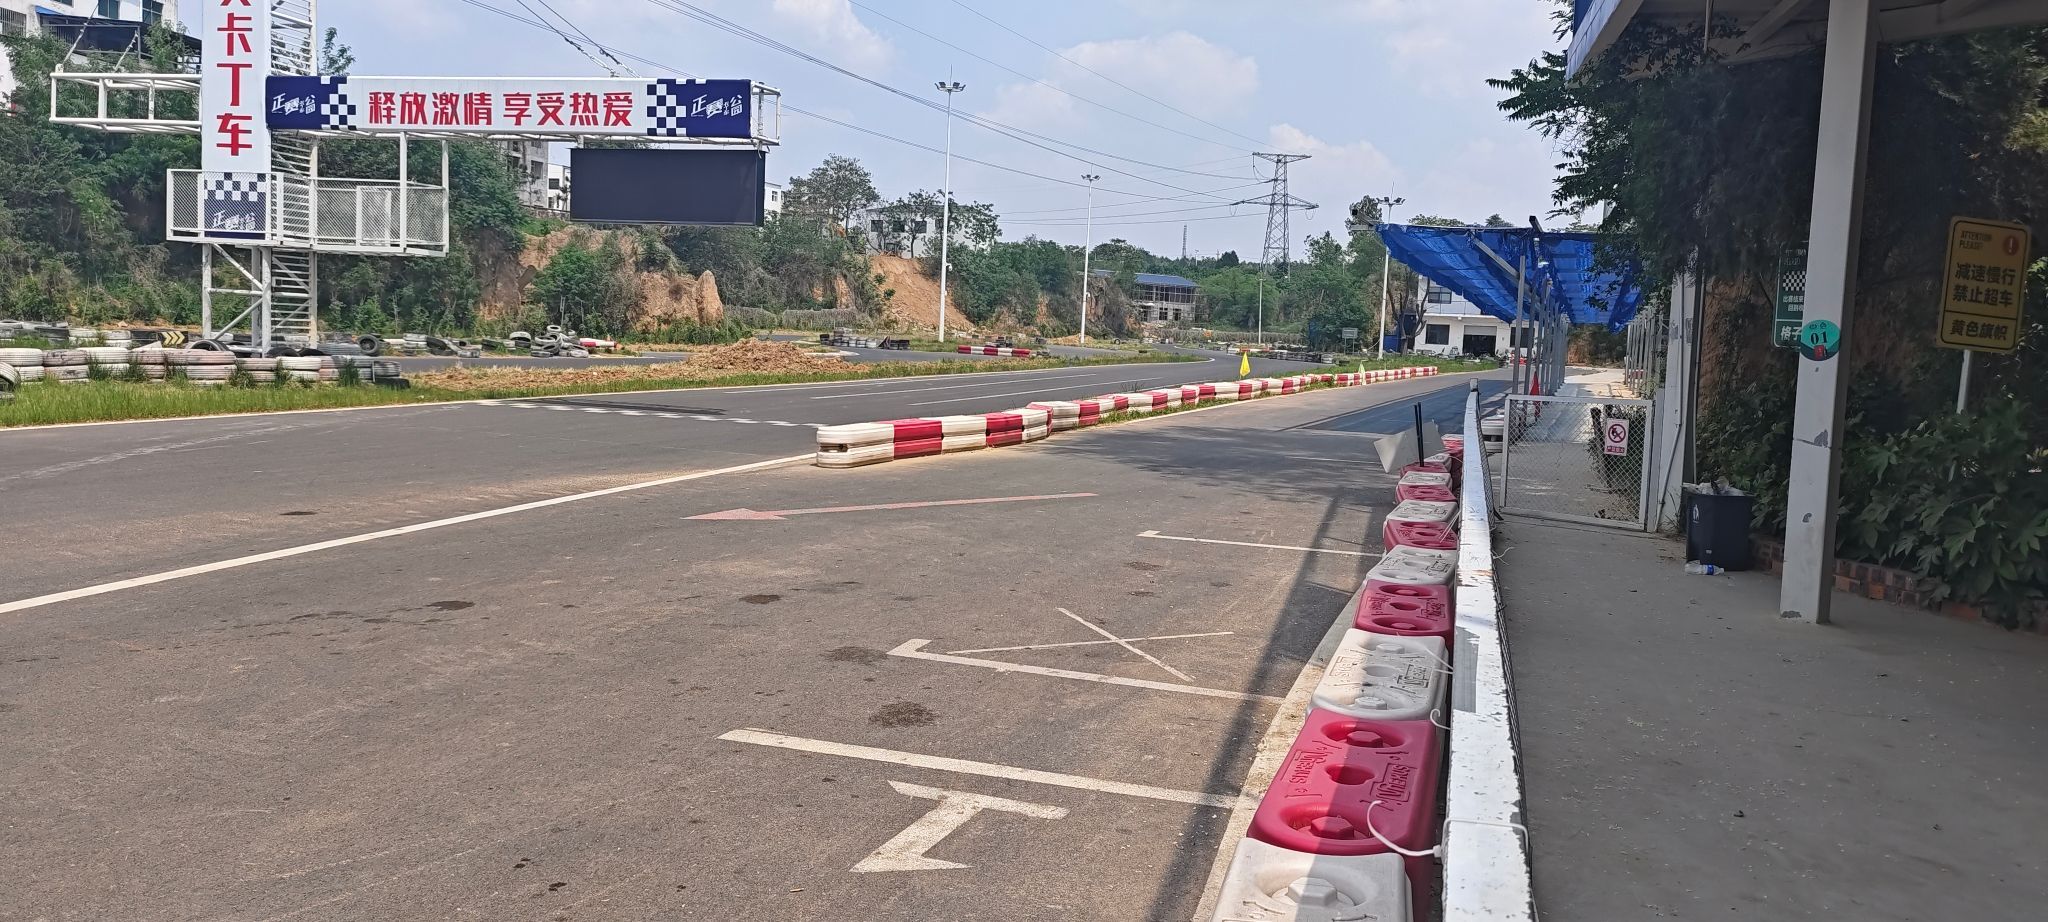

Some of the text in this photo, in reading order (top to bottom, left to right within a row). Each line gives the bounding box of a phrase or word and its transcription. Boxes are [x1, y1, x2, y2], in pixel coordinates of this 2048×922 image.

[368, 91, 633, 127] 释放激情 享受热爱
[1955, 262, 2016, 286] 减速慢行
[1952, 283, 2014, 308] 禁止超车
[1810, 331, 1828, 345] 01
[1950, 319, 2009, 341] 黄色旗帜
